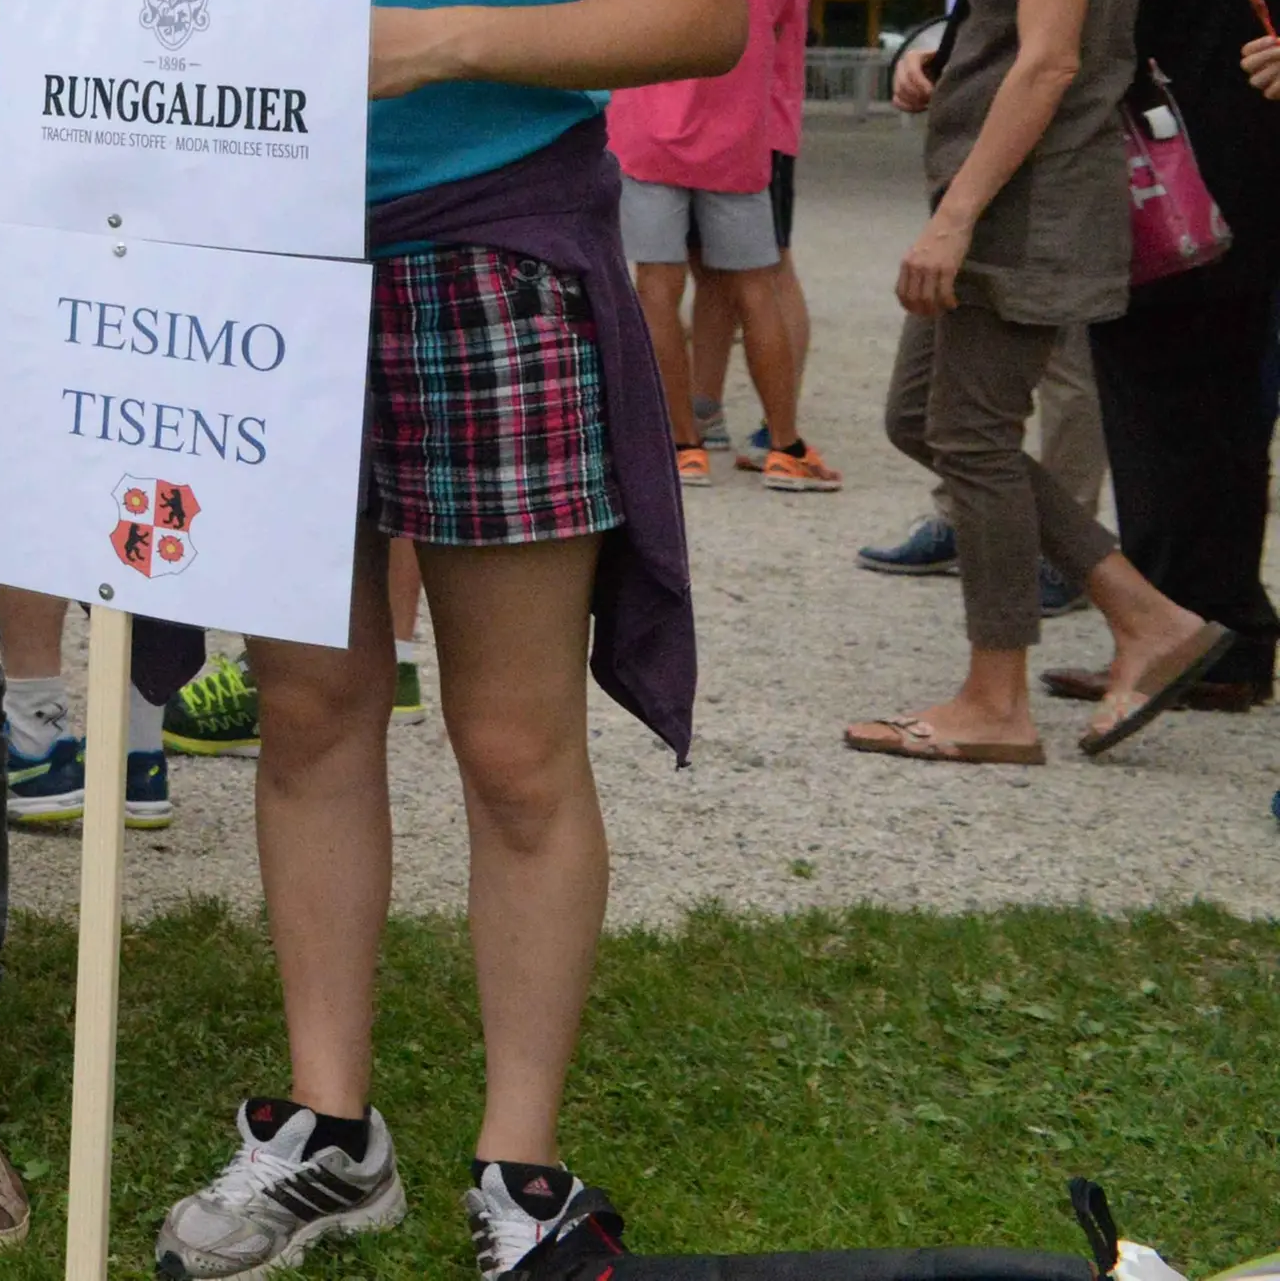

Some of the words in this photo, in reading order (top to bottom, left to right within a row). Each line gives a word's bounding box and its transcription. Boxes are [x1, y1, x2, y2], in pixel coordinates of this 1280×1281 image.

[158, 56, 186, 71] 1896
[42, 74, 308, 133] RUNGGALDIER
[41, 126, 92, 144] TRACHTEN
[94, 130, 126, 146] MODE
[129, 132, 167, 149] STOFFE
[175, 136, 210, 153] MODA
[212, 139, 262, 156] TIROLESE
[265, 142, 309, 159] TESSUTI
[58, 297, 286, 372] TESIMO
[62, 388, 267, 465] TISENS
